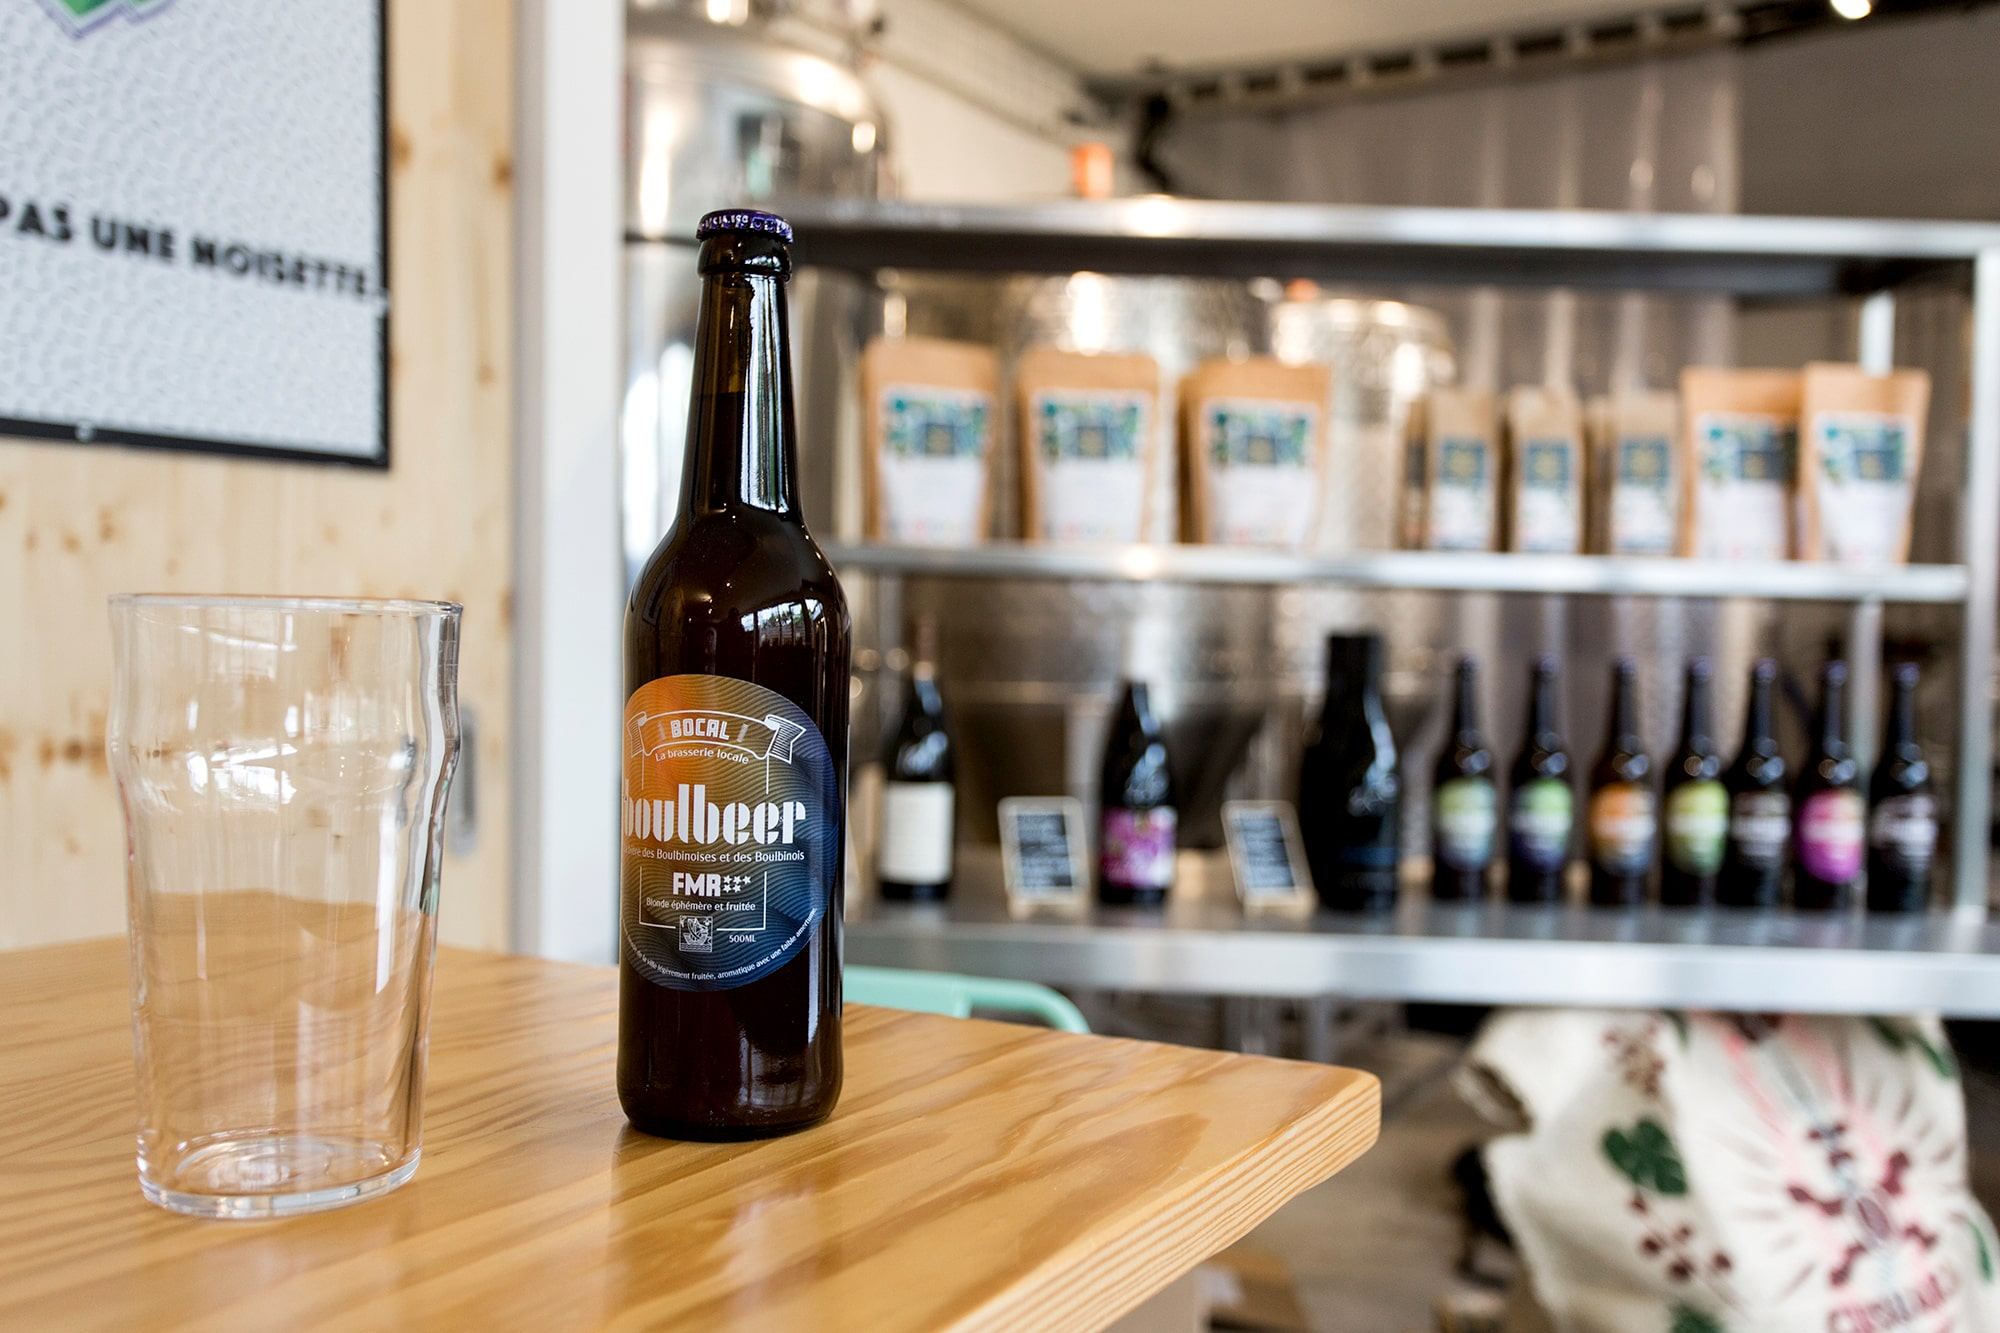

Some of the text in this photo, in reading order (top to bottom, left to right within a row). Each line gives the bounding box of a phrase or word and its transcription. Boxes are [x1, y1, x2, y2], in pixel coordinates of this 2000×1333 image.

[91, 214, 175, 260] UNE
[192, 233, 366, 296] NOISETTE
[670, 718, 730, 741] BOCAL
[655, 747, 750, 765] La brasserie locale
[624, 778, 806, 845] boulbeer
[642, 847, 655, 858] des
[656, 849, 717, 863] Boulbinoises
[719, 852, 730, 862] et
[733, 851, 752, 863] des
[755, 850, 805, 863] Boulbinois
[672, 871, 721, 897] FMR
[646, 897, 756, 912] Blonde éphémère et fruitée
[729, 934, 757, 943] 500ML
[717, 963, 756, 979] aromatique
[756, 955, 770, 968] avec
[770, 948, 782, 960] une
